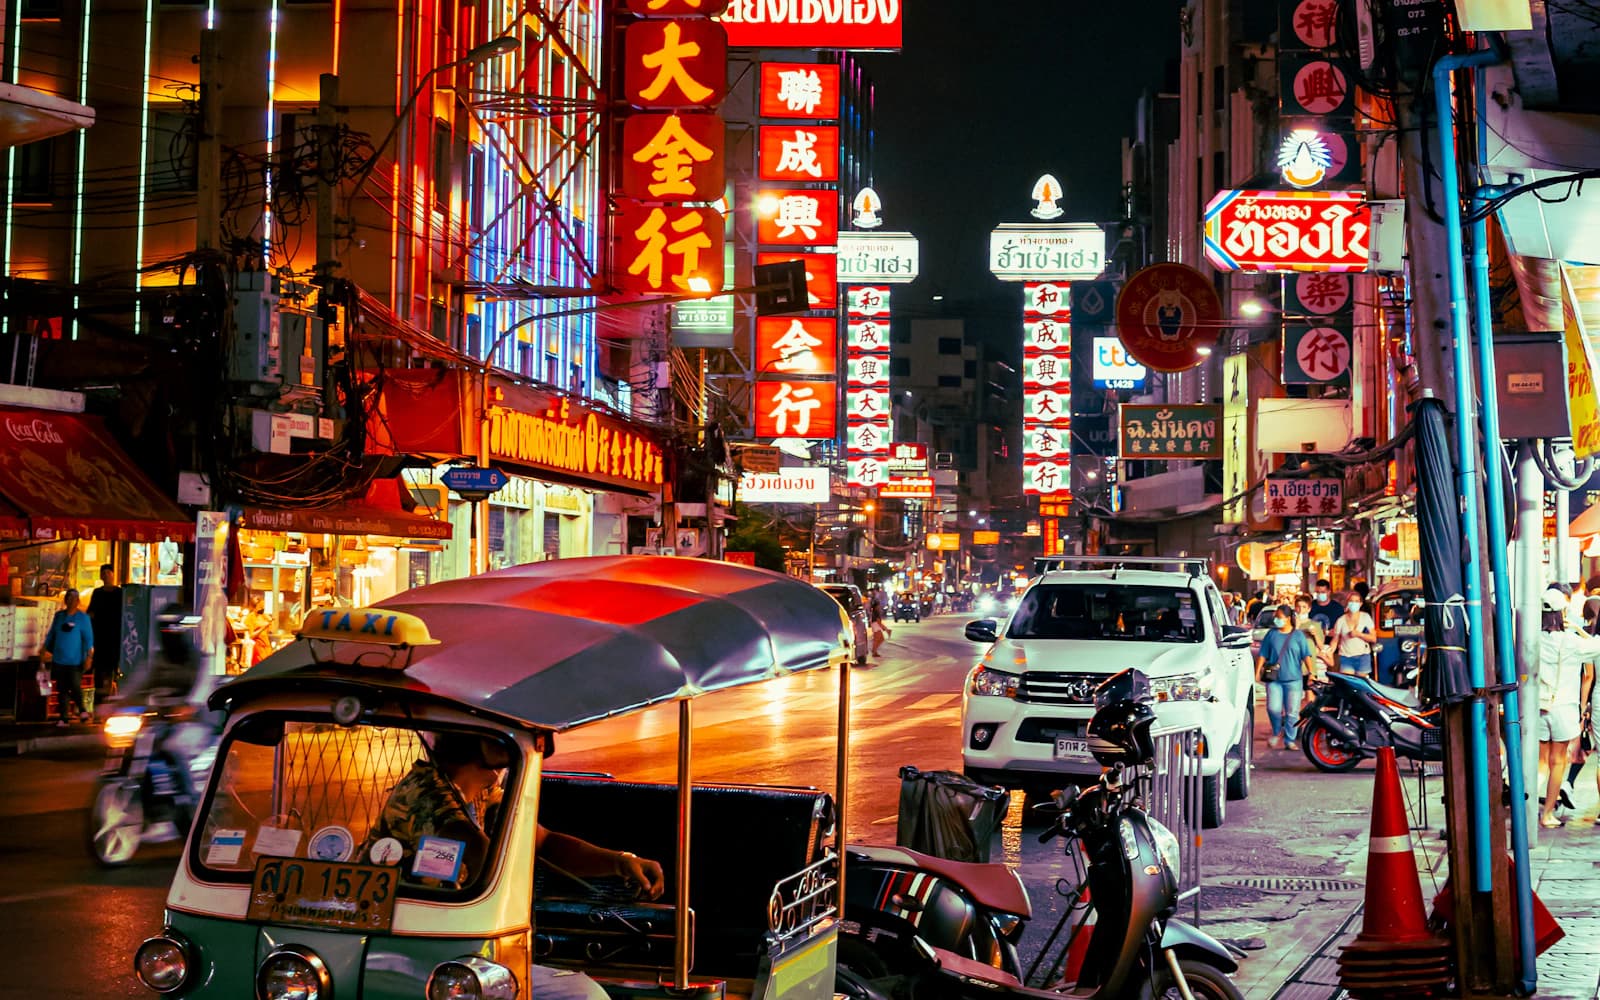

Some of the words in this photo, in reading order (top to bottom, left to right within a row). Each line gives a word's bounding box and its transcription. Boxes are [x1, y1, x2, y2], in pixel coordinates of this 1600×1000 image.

[628, 0, 714, 289] 大金行
[769, 70, 823, 434] 聯成興金行
[678, 313, 727, 322] WISDOM
[857, 291, 880, 483] 和成興大金行
[1034, 286, 1058, 488] 和成興大金行
[490, 473, 498, 485] 6
[322, 610, 398, 636] TAXI
[321, 866, 391, 903] 1573
